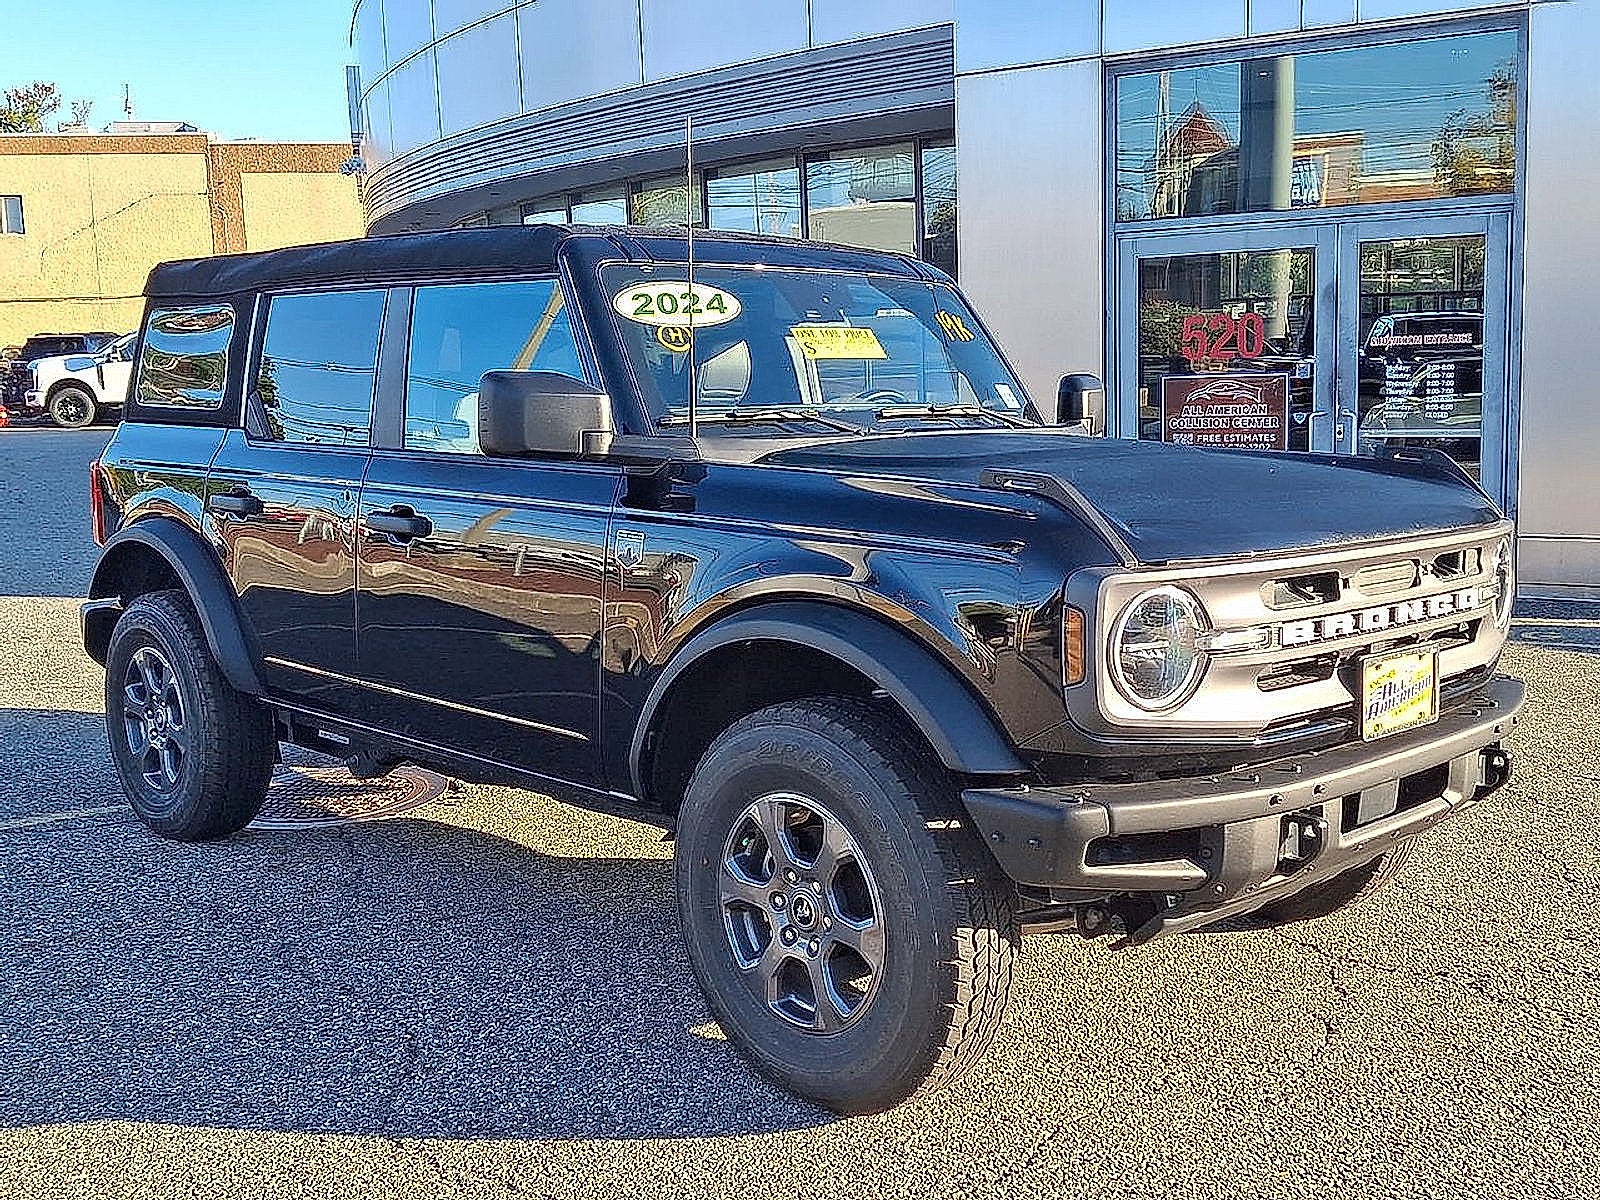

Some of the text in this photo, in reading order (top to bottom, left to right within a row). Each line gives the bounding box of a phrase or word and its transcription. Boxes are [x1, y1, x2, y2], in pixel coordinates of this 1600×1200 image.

[631, 292, 728, 315] 2024
[1181, 312, 1265, 361] 520
[1423, 333, 1473, 344] ENTRANCE
[1182, 404, 1268, 417] ALL AMERICAN
[1169, 417, 1280, 429] COLLISION CENTER
[1197, 434, 1221, 442] FREE
[1224, 434, 1277, 442] ESTIMATES
[1281, 585, 1479, 647] BRONCO
